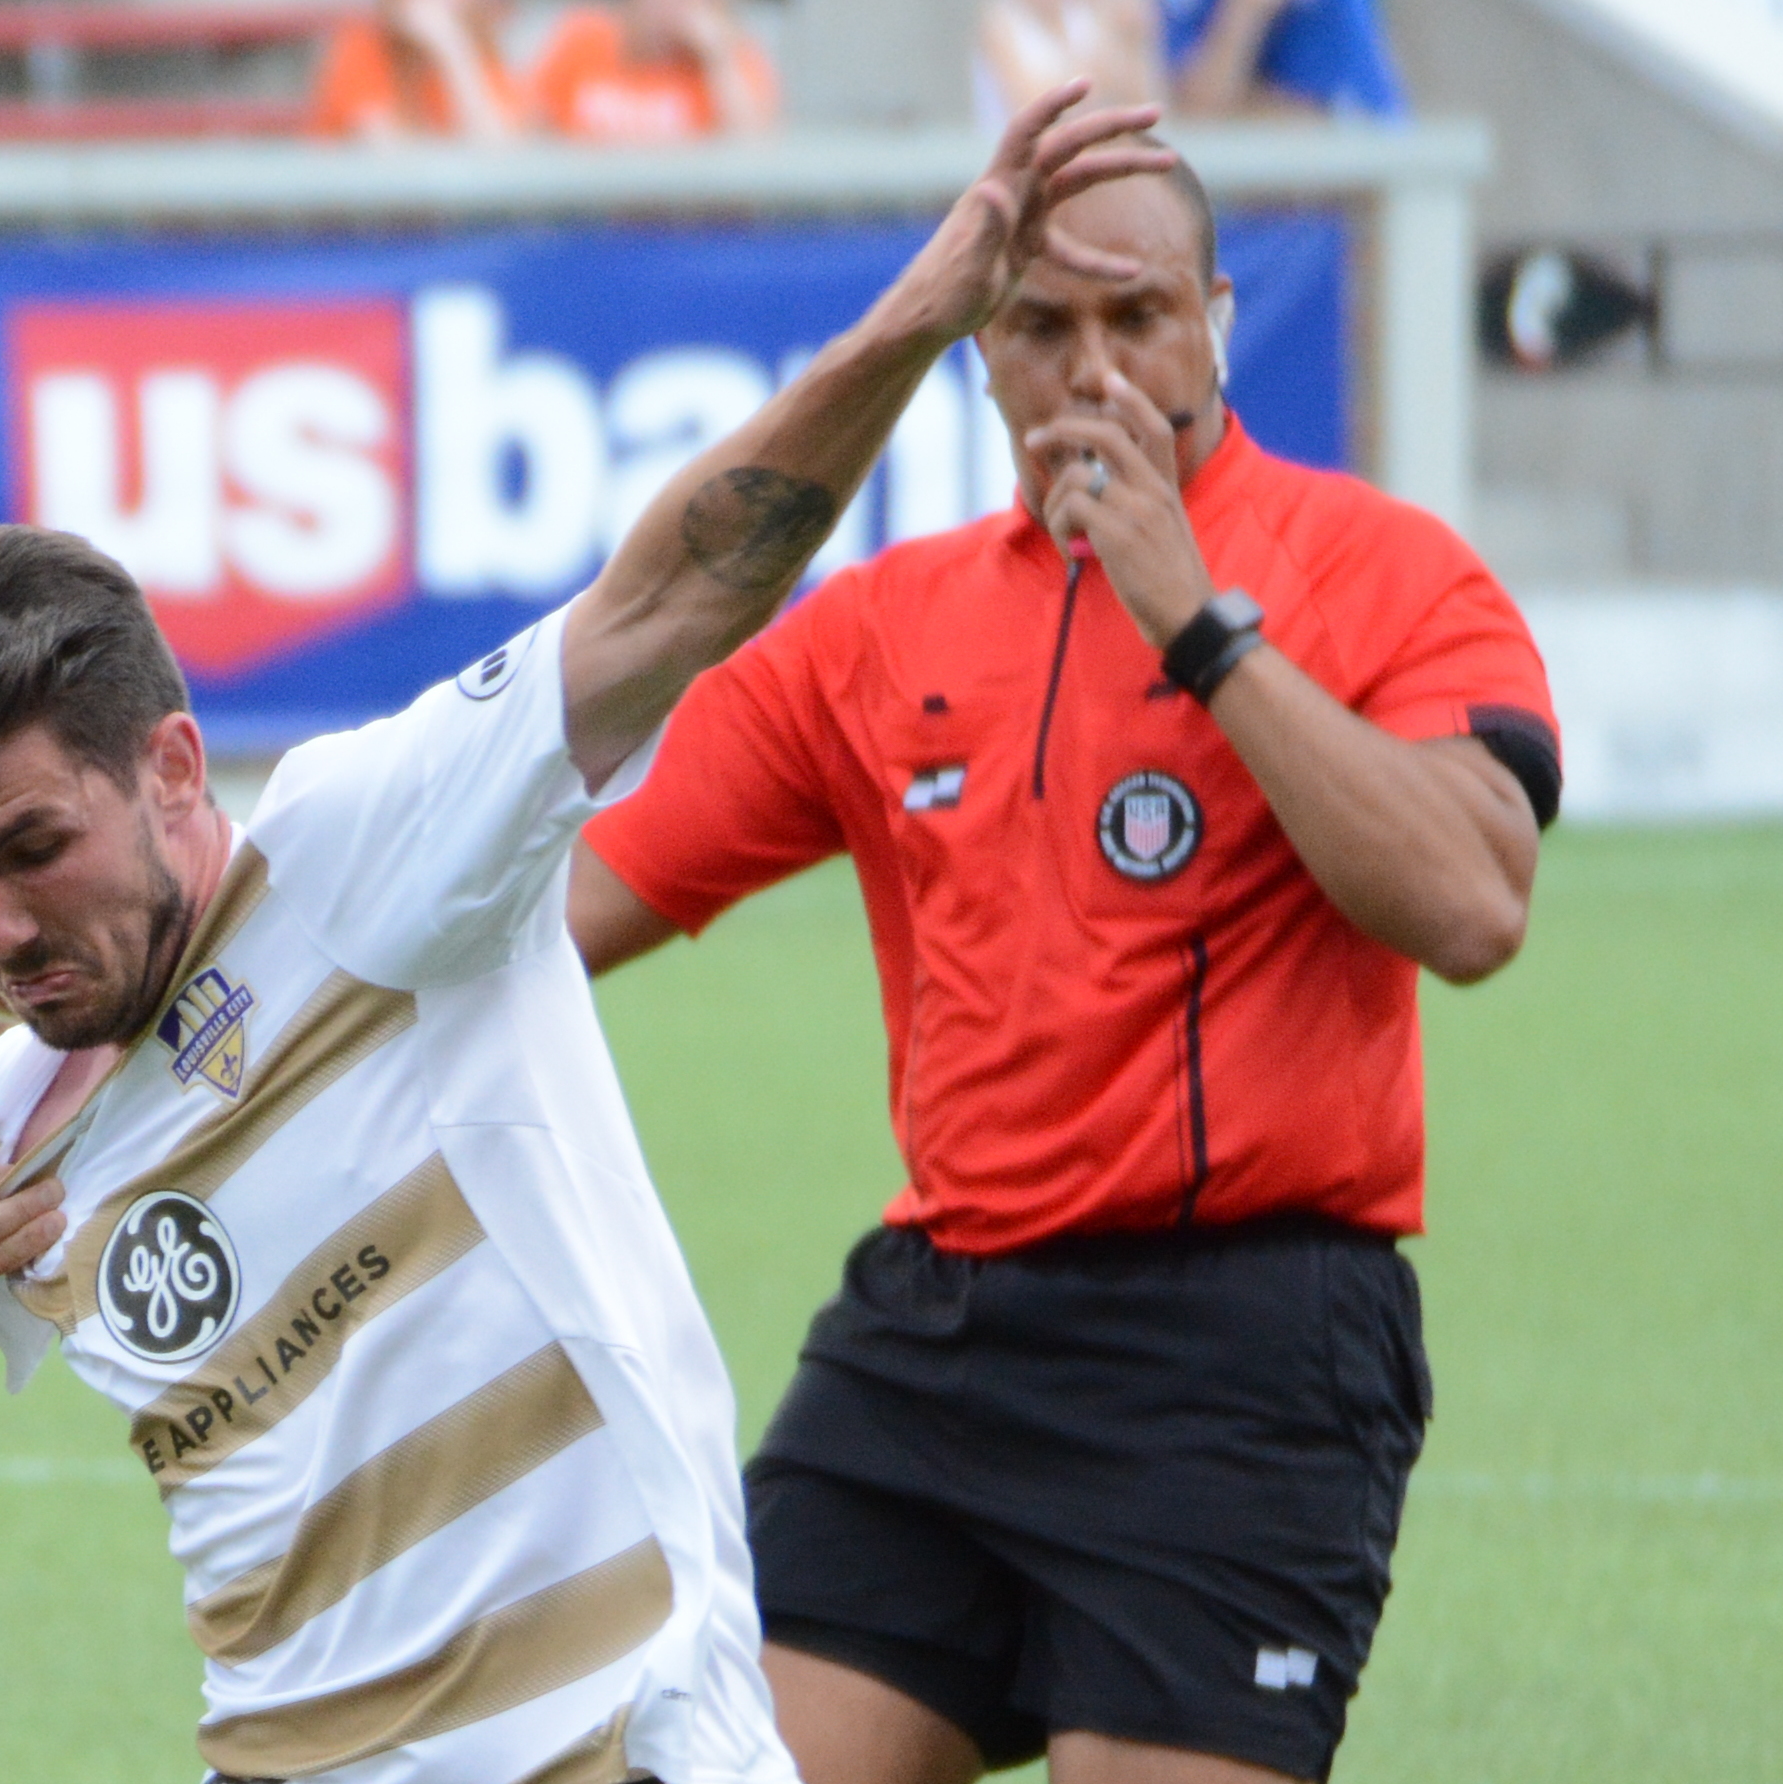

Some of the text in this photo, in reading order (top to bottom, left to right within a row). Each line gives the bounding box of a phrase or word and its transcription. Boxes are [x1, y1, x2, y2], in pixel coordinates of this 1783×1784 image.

[176, 988, 251, 1080] LOUISVILLE CITY
[167, 1244, 391, 1458] APPLIANCES
